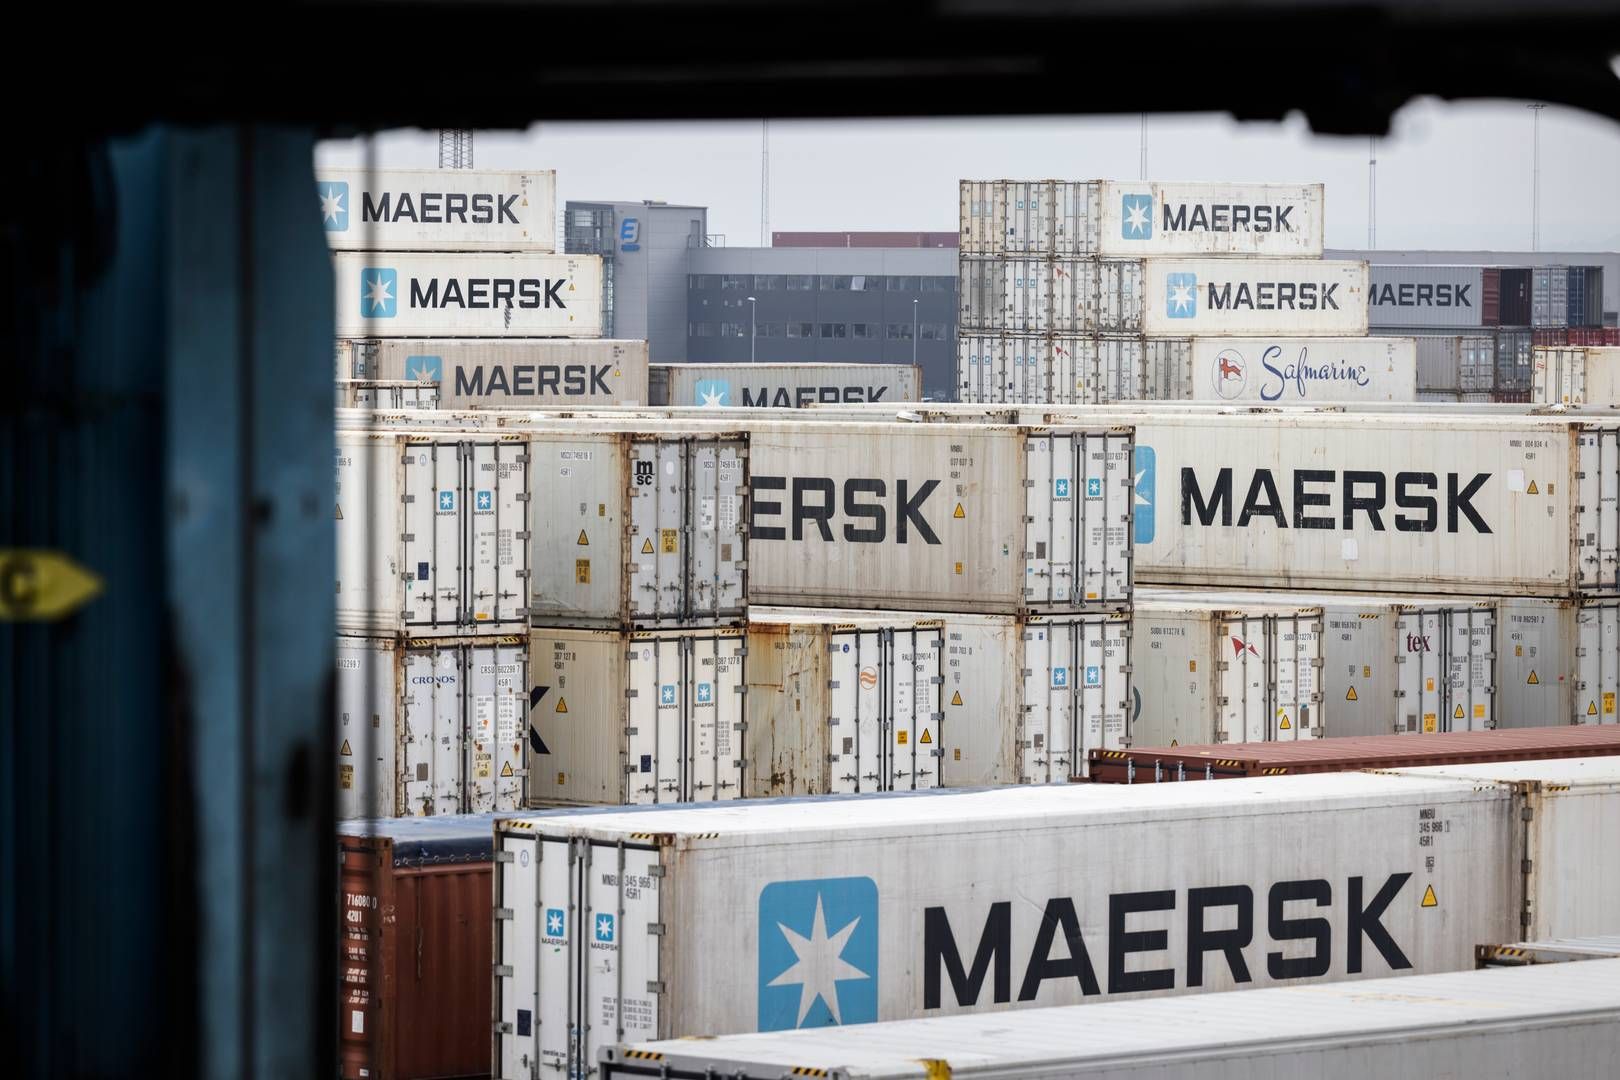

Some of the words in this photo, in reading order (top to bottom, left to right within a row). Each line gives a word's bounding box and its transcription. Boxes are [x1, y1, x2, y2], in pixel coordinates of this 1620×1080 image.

[362, 192, 519, 224] MAERSK
[1163, 204, 1295, 233] MAERSK
[410, 278, 566, 309] MAERSK
[1208, 282, 1339, 310] MAERSK
[455, 365, 612, 396] MAERSK
[1260, 345, 1370, 400] Safmarine
[637, 474, 652, 485] sc
[750, 476, 942, 544] ERSK
[1180, 467, 1494, 534] MAERSK
[1407, 632, 1431, 652] tex
[412, 676, 456, 684] CRONOS
[1420, 808, 1436, 820] MNBU
[1419, 822, 1430, 833] 345
[1432, 821, 1443, 832] 966
[1419, 835, 1433, 847] 45R1
[602, 874, 620, 887] MNBU
[625, 875, 637, 887] 345
[639, 876, 651, 889] 966
[625, 888, 641, 900] 45R1
[541, 937, 569, 946] MAERSK
[590, 942, 618, 951] MAERSK
[924, 872, 1414, 1009] MAERSK
